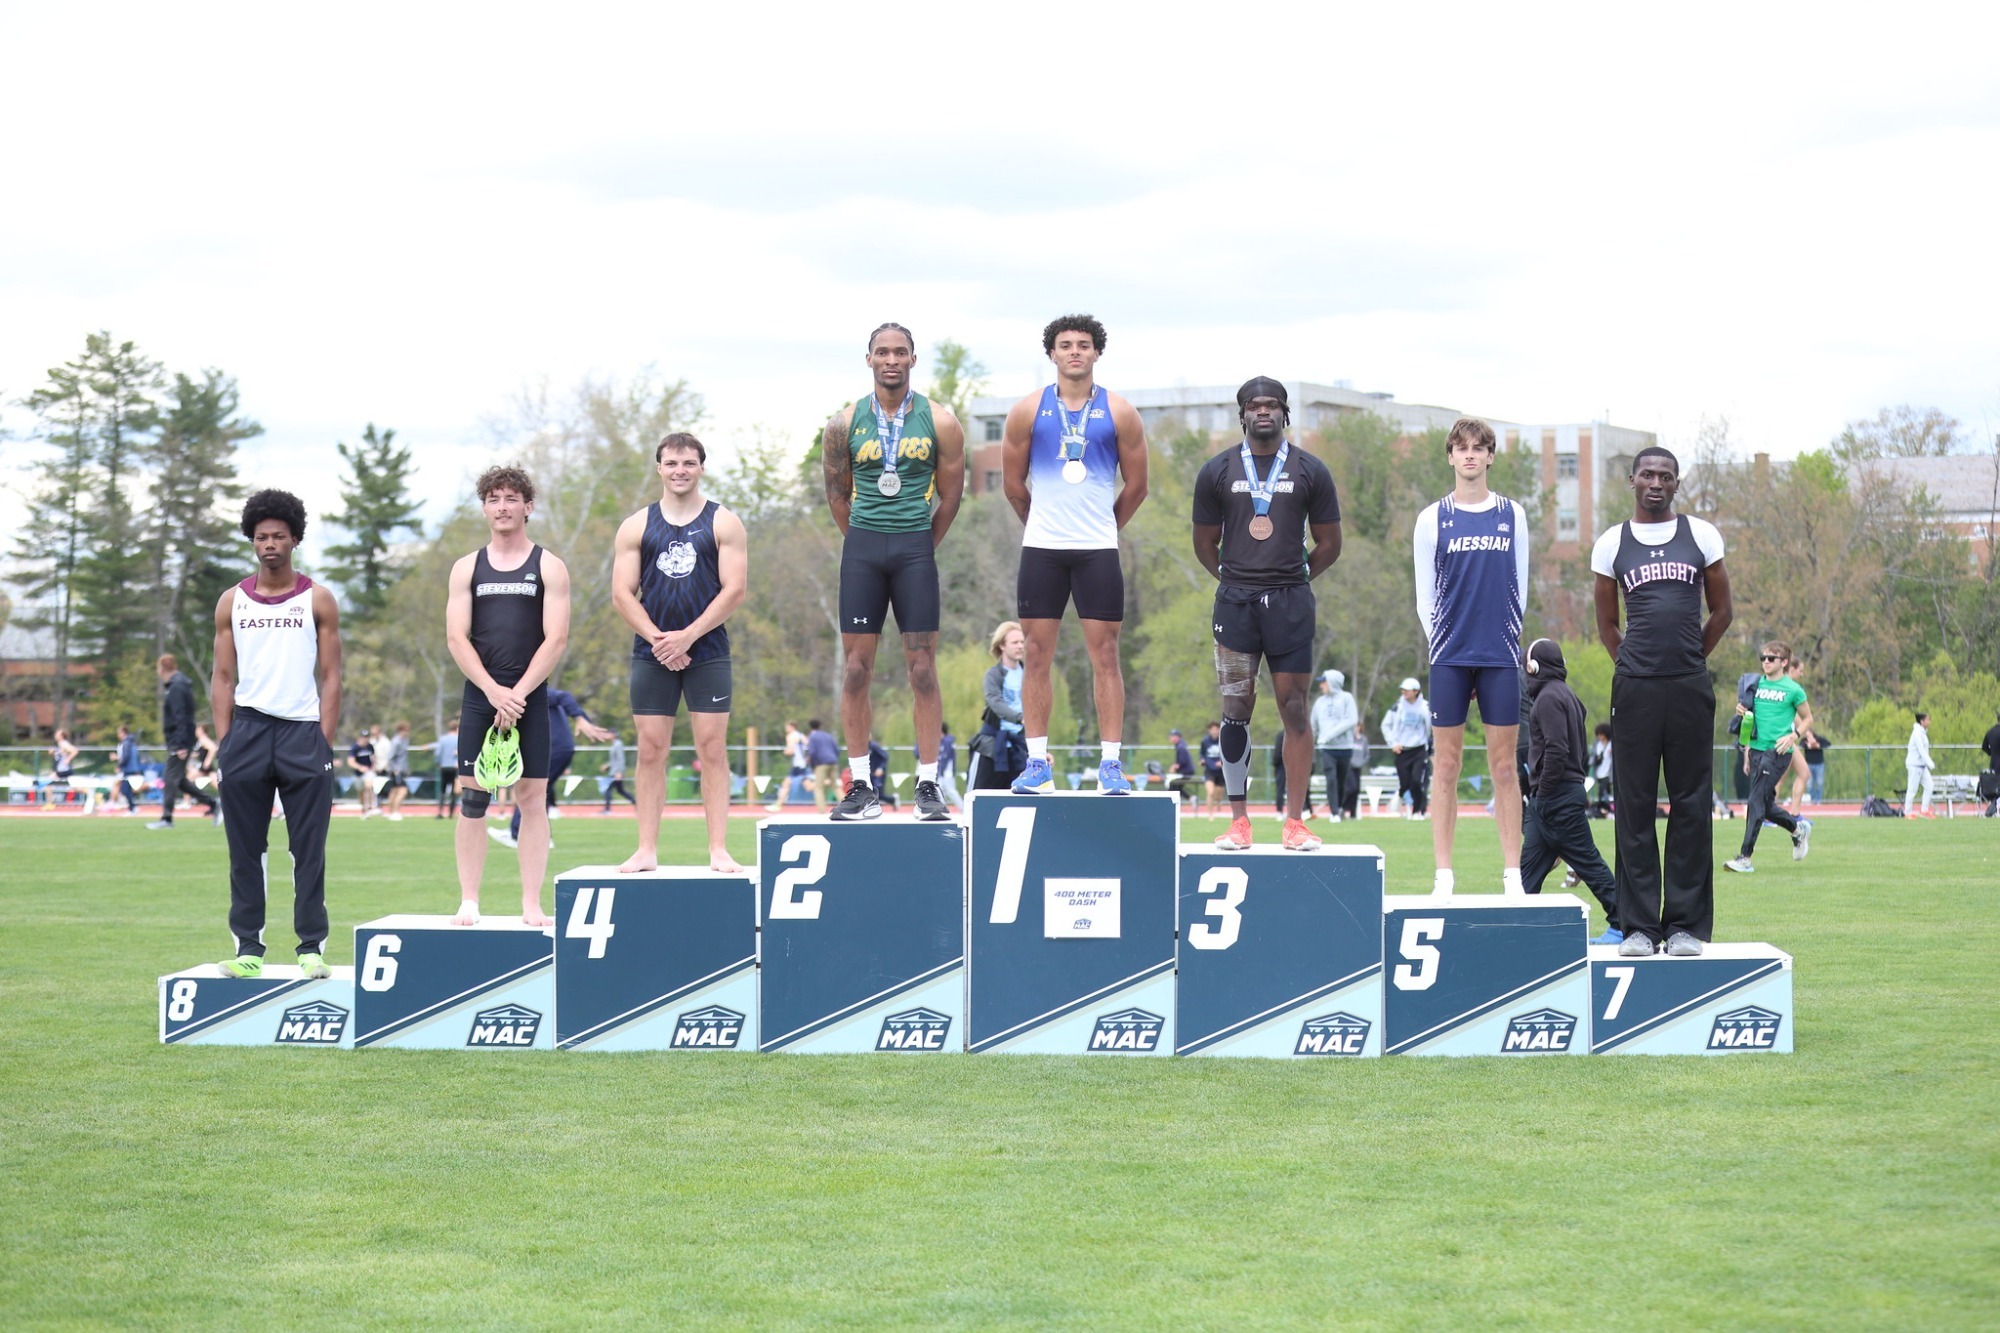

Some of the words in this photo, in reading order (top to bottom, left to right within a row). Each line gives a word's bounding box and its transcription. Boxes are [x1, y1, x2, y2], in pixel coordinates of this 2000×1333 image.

[855, 437, 932, 463] AGIES
[1447, 536, 1510, 554] MESSIAH
[1623, 562, 1697, 592] ALBRIGHT
[476, 582, 537, 597] STEVENSON
[239, 618, 303, 629] EASTERN
[1755, 688, 1786, 701] YORK
[989, 807, 1036, 923] 1
[769, 835, 831, 919] 2
[1188, 866, 1248, 950] 3
[565, 888, 615, 958] 4
[360, 934, 402, 991] 6
[1393, 918, 1444, 991] 5
[168, 980, 198, 1021] 8
[1602, 967, 1635, 1020] 7
[280, 1022, 342, 1040] MAC
[471, 1026, 535, 1044] MAC
[674, 1027, 738, 1046] MAC
[879, 1030, 944, 1049] MAC
[1092, 1030, 1158, 1049] MAC
[1506, 1030, 1570, 1050] MAC
[1711, 1028, 1776, 1047] MAC
[1299, 1034, 1364, 1053] MAC
